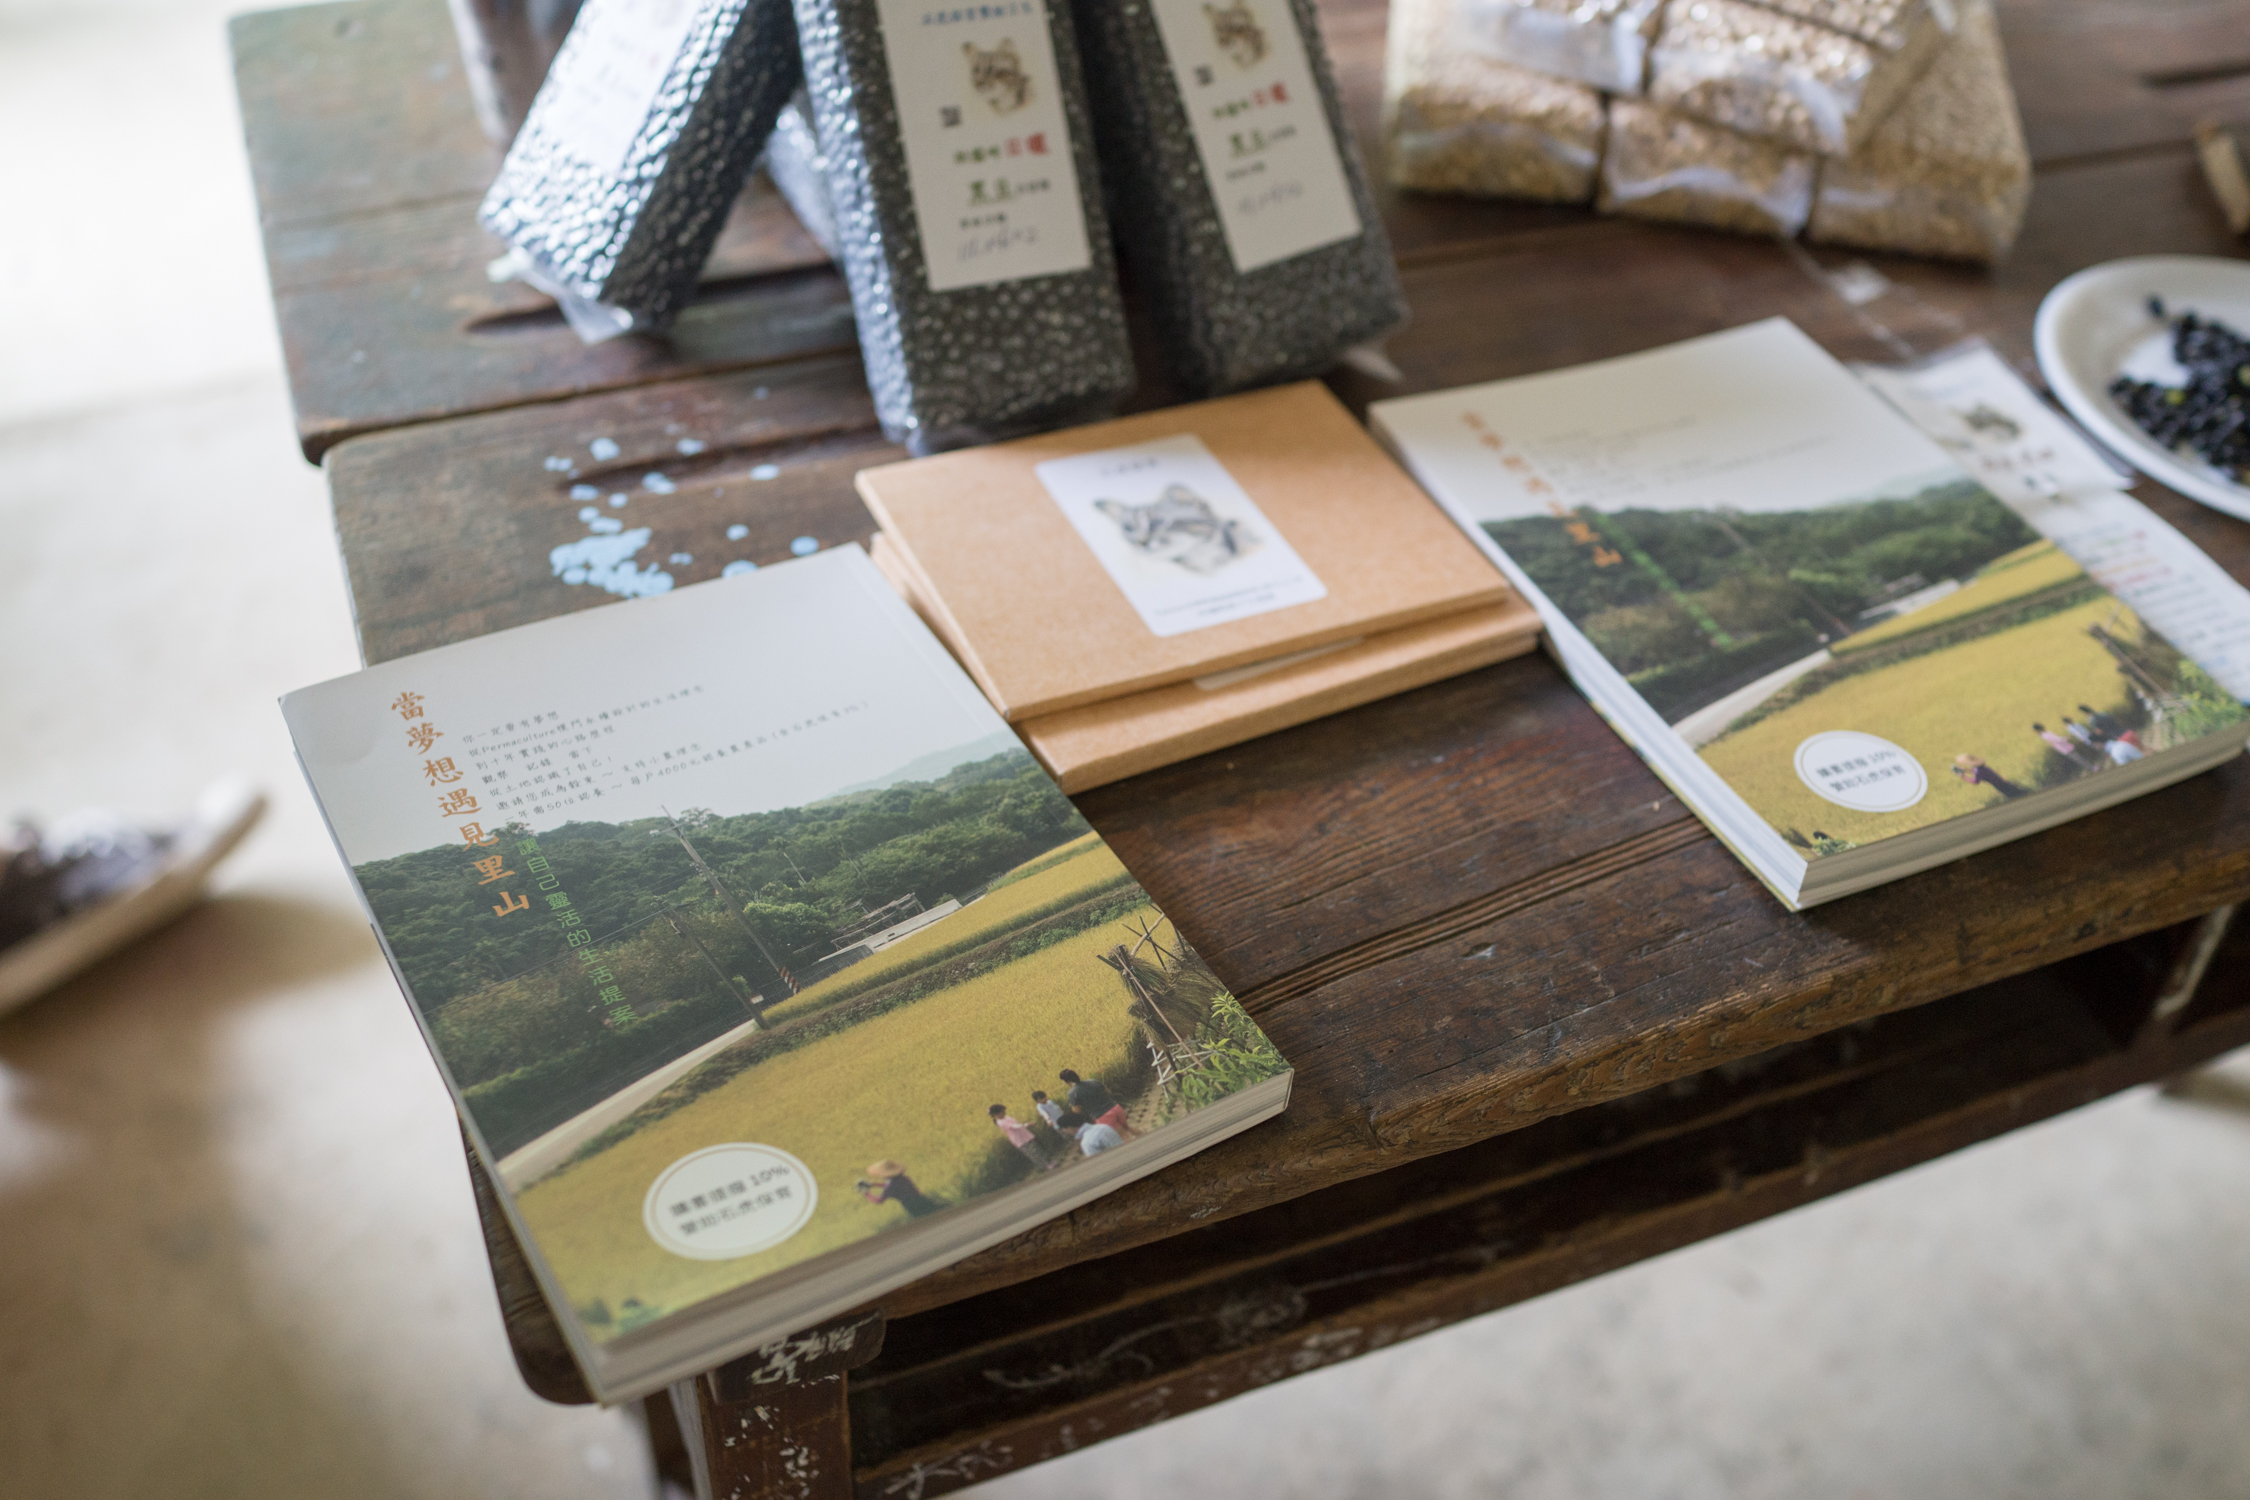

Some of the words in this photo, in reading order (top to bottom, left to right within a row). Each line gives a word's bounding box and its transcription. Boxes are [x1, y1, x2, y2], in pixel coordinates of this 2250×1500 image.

[462, 710, 559, 744] 你一定要有夢想
[391, 691, 530, 917] 當夢想遇見里山
[516, 836, 638, 1026] 讓自己靈活的生活提案
[750, 1165, 790, 1187] 10%
